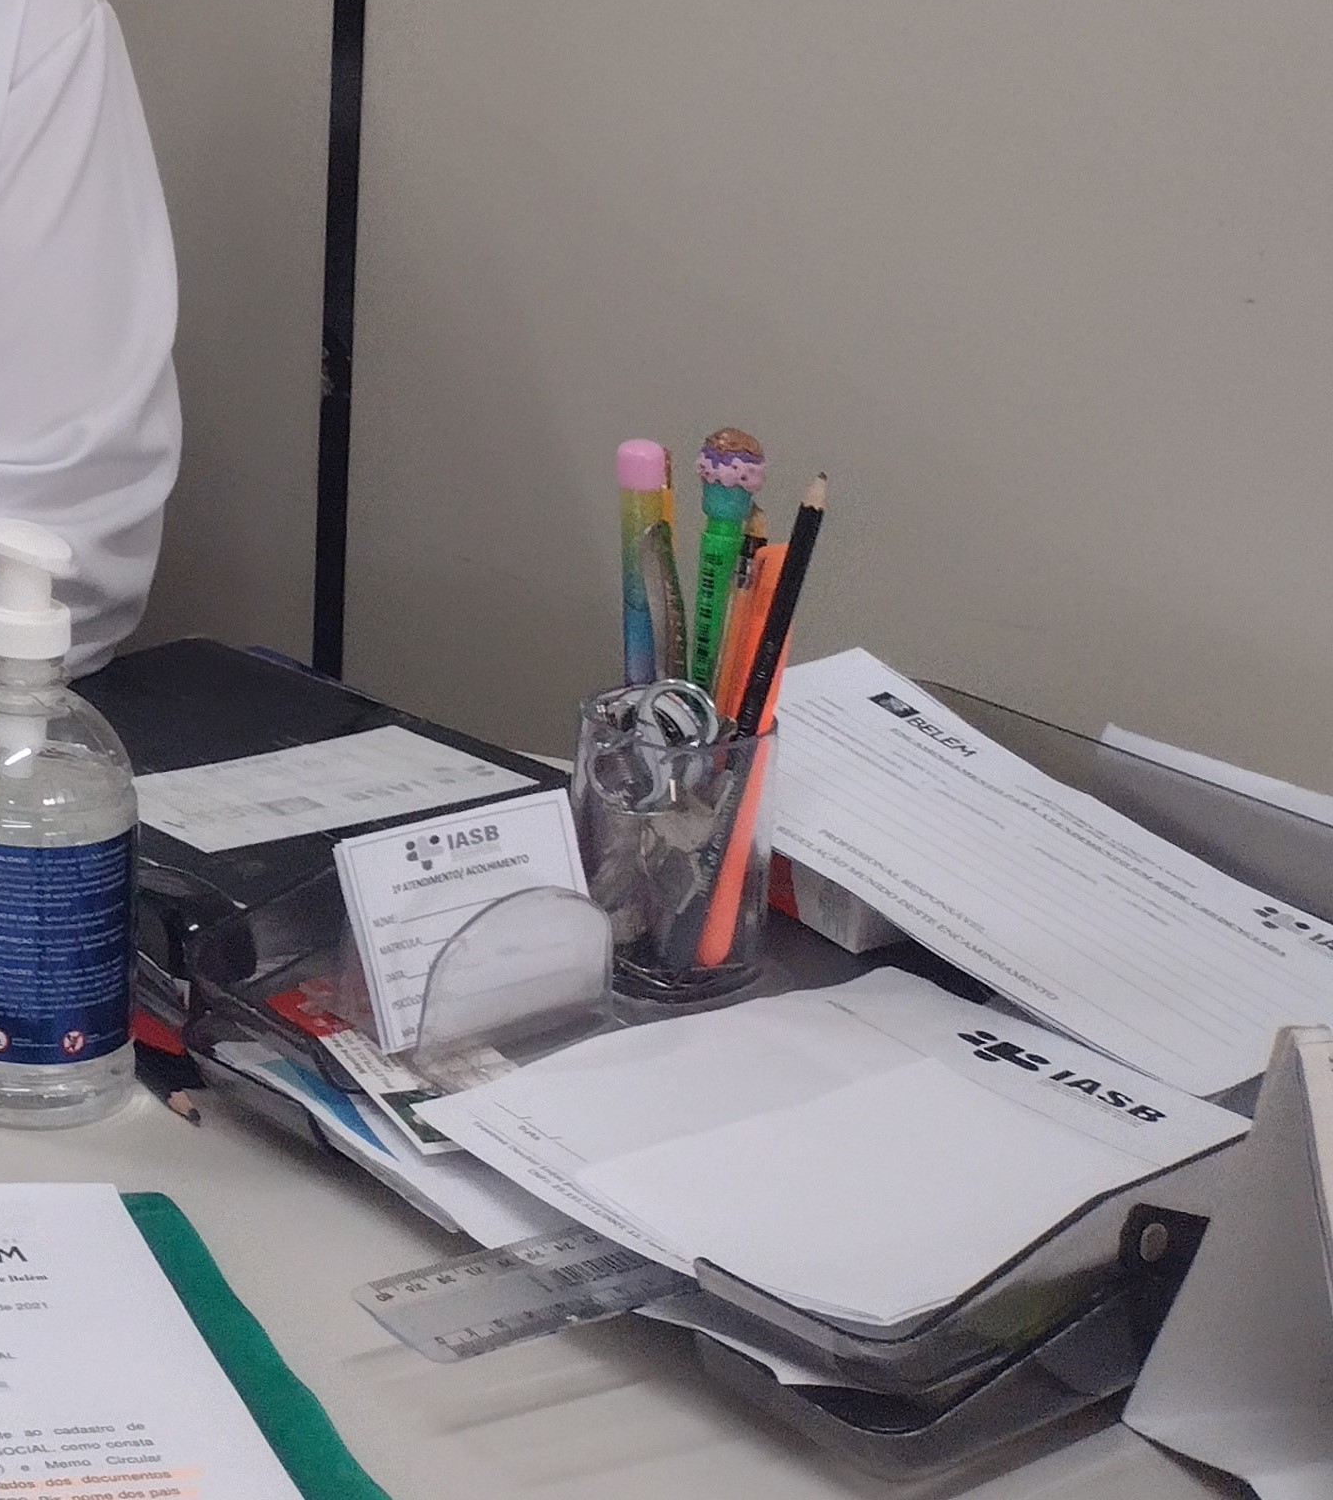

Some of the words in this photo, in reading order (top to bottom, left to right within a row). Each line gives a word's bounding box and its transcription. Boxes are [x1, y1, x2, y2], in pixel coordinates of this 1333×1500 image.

[446, 824, 501, 851] IASB
[1048, 1069, 1167, 1123] IASB
[24, 1428, 43, 1437] ao
[53, 1424, 116, 1435] cadastro
[126, 1422, 146, 1431] de
[60, 1442, 102, 1451] como
[105, 1437, 154, 1448] consta
[105, 1453, 163, 1467] Circular
[45, 1476, 73, 1487] dos
[80, 1469, 173, 1486] documentos
